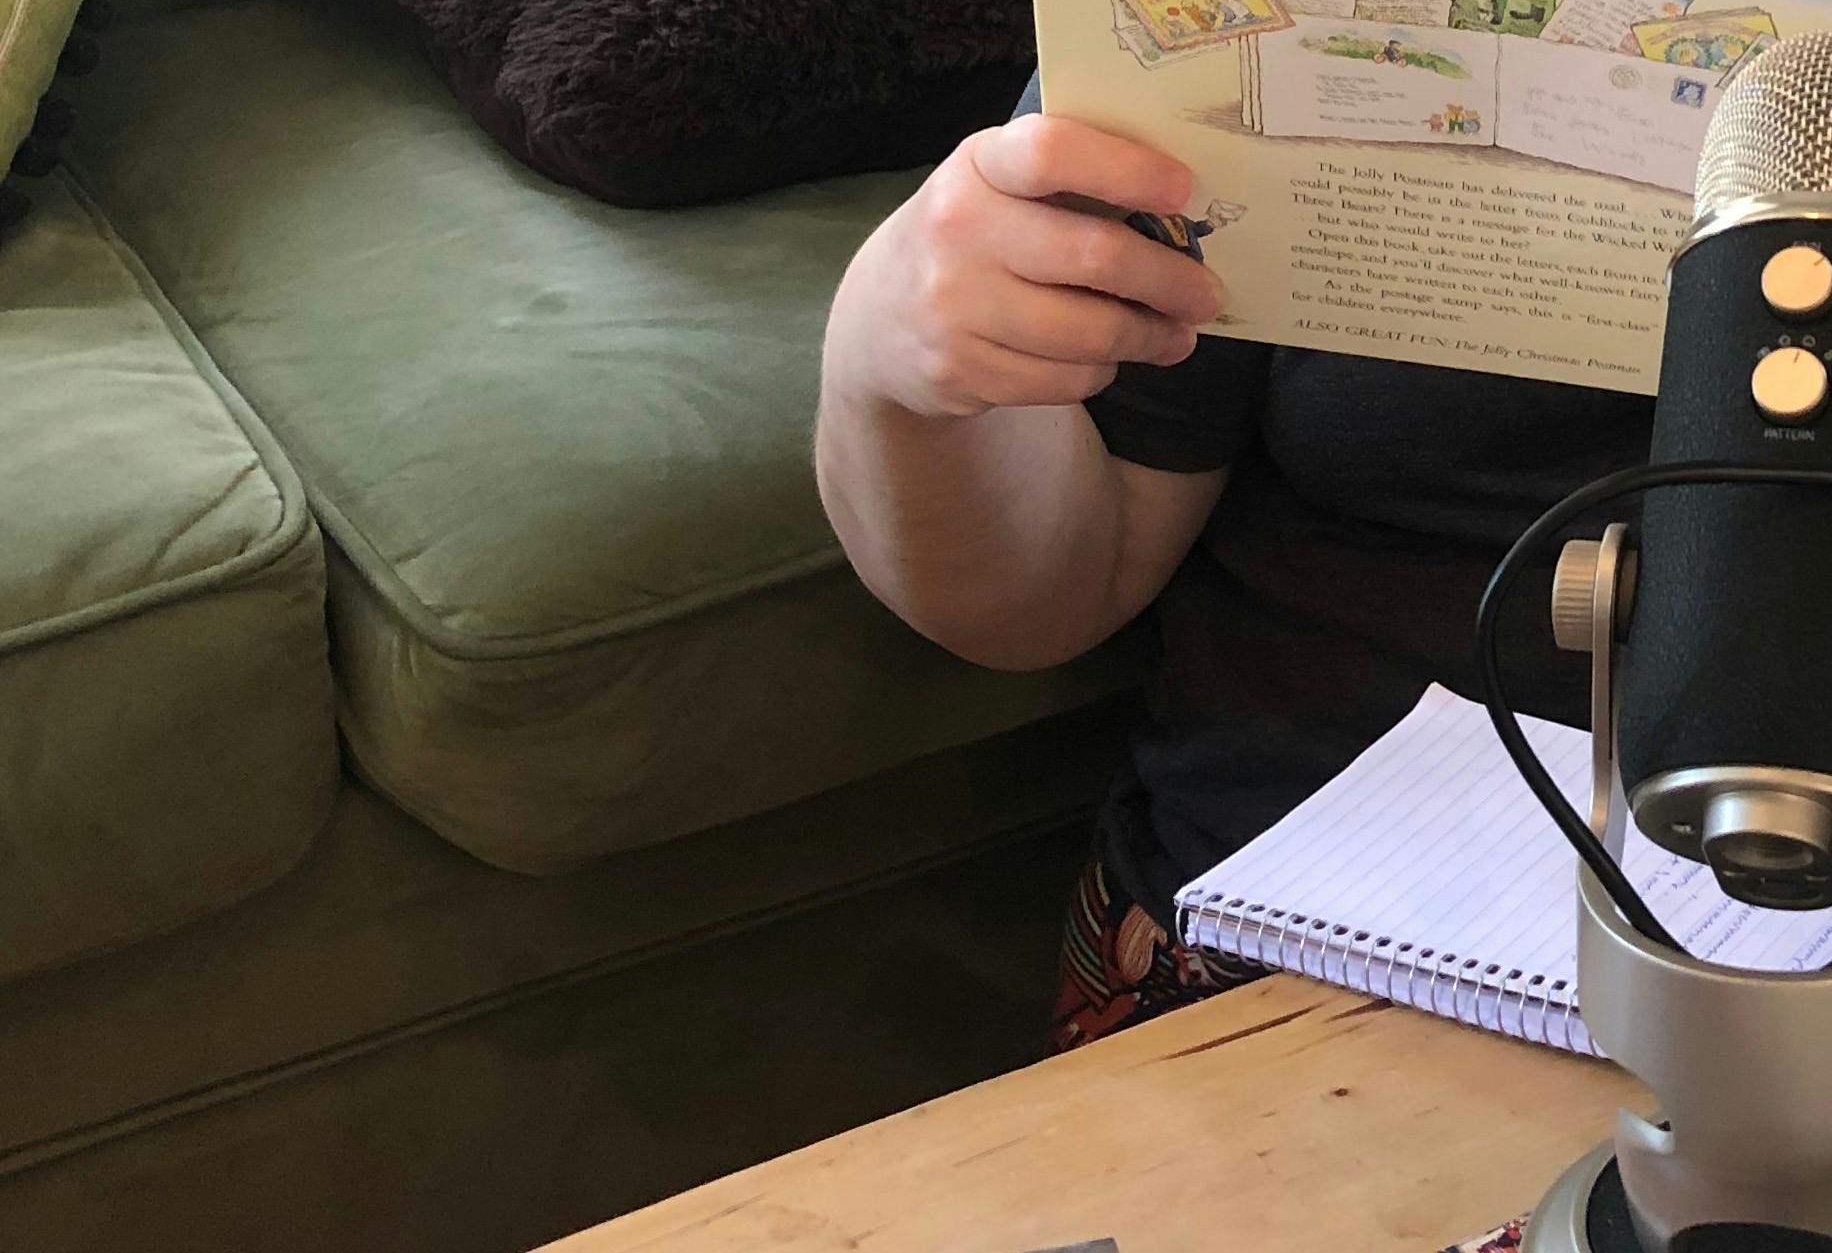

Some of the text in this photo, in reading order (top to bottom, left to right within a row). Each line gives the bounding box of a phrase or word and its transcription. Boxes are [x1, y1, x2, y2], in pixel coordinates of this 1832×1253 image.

[1289, 178, 1331, 191] could
[1338, 184, 1395, 202] possibly
[1402, 190, 1420, 203] be
[1427, 196, 1442, 206] in
[1450, 196, 1472, 209] the
[1480, 200, 1517, 216] letter
[1525, 208, 1561, 223] from
[1567, 212, 1646, 234] Goldilocks
[1652, 226, 1668, 238] to
[1317, 161, 1346, 175] The
[1352, 166, 1384, 183] Jolly
[1392, 171, 1454, 190] Postman
[1461, 181, 1485, 194] has
[1491, 186, 1557, 204] delivered
[1563, 195, 1586, 208] the
[1291, 192, 1334, 209] Three
[1341, 198, 1386, 214] Bears?
[1394, 205, 1435, 222] There
[1441, 214, 1451, 224] is
[1472, 219, 1529, 235] message
[1535, 225, 1555, 237] for
[1563, 228, 1586, 243] the
[1592, 232, 1647, 250] Wicked
[1317, 212, 1530, 250] but who would write to her?
[1291, 260, 1361, 278] characters
[1366, 268, 1400, 283] have
[1404, 275, 1457, 291] written
[1462, 282, 1477, 293] to
[1482, 285, 1515, 298] each
[1308, 229, 1350, 244] Open
[1353, 234, 1380, 248] this
[1427, 244, 1457, 258] take
[1461, 251, 1485, 262] out
[1489, 252, 1513, 265] the
[1566, 264, 1599, 278] each
[1603, 268, 1639, 283] from
[1641, 275, 1657, 285] its
[1361, 253, 1388, 265] and
[1391, 257, 1432, 271] you'll
[1436, 262, 1494, 279] discover
[1500, 271, 1535, 285] what
[1539, 277, 1625, 298] well-known
[1629, 288, 1661, 304] fairy
[1291, 290, 1314, 303] for
[1317, 294, 1375, 312] children
[1324, 278, 1343, 291] As
[1349, 283, 1374, 295] the
[1380, 289, 1435, 304] postage
[1441, 297, 1483, 312] stamp
[1528, 306, 1554, 319] this
[1561, 313, 1573, 322] is
[1295, 318, 1340, 334] ALSO
[1345, 325, 1407, 342] GREAT
[1454, 338, 1479, 350] The
[1481, 343, 1512, 359] Jolly
[1516, 349, 1582, 367] Christmas
[1587, 357, 1642, 375] Postman
[1764, 427, 1815, 442] PATTERN
